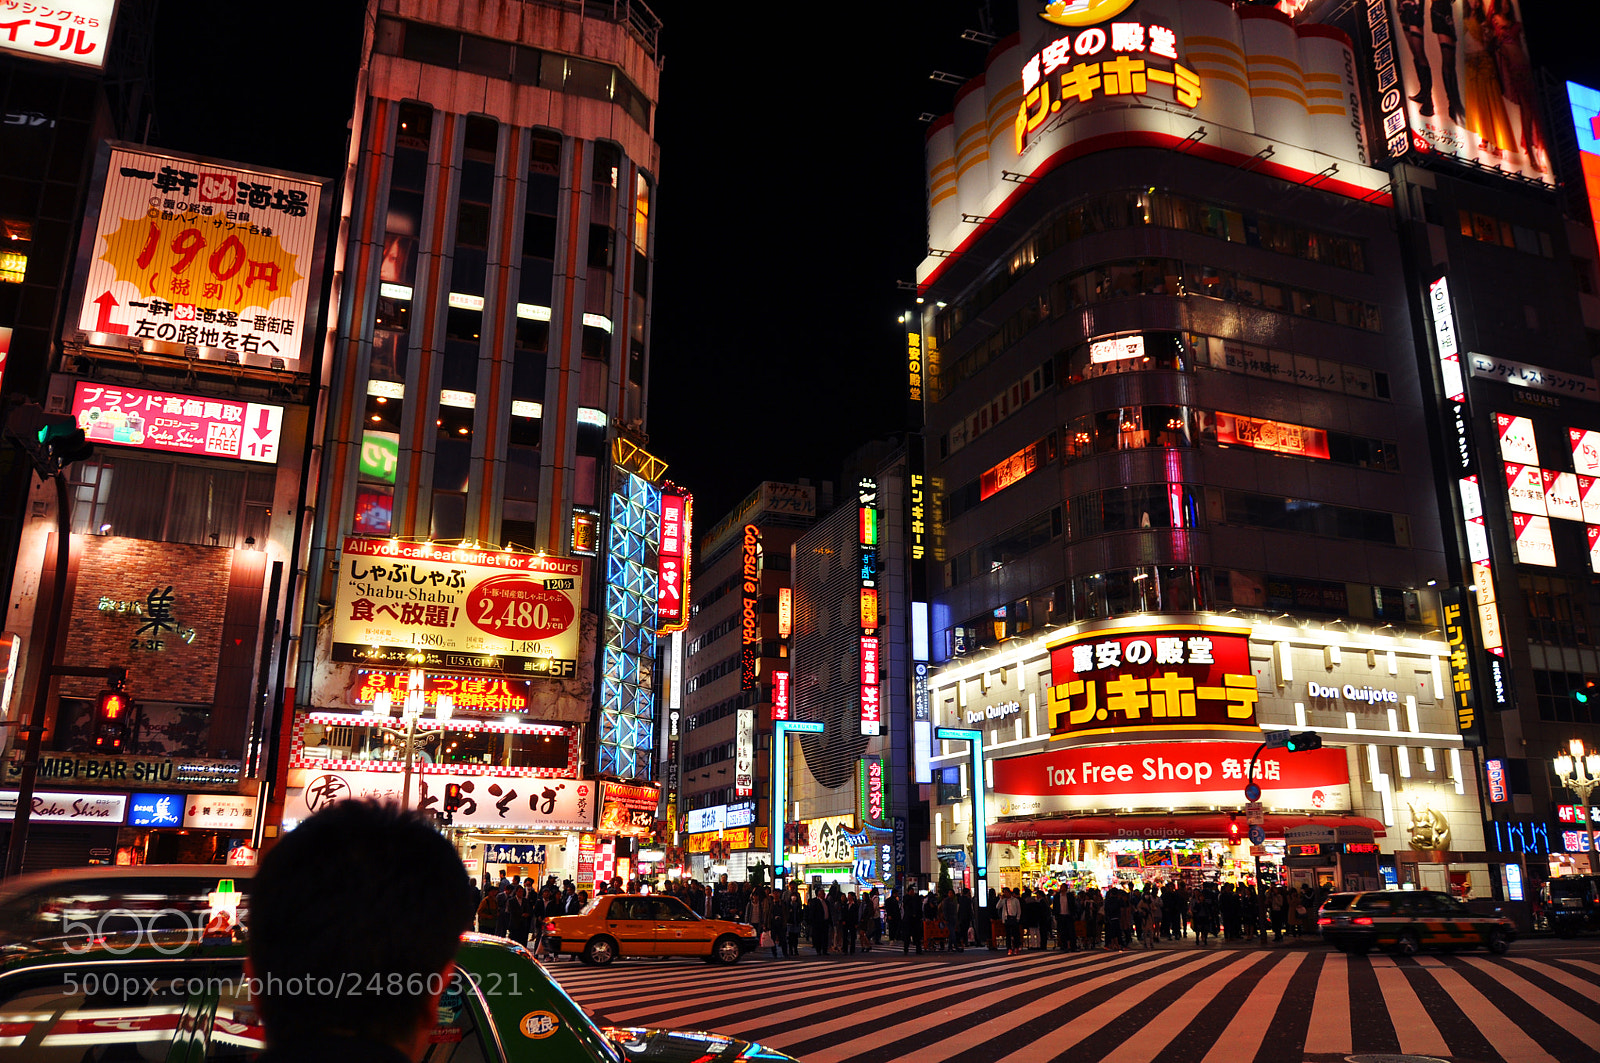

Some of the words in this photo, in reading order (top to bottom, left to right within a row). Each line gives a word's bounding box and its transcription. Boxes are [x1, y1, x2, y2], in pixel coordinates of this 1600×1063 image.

[120, 165, 310, 218] 一軒め酒場
[134, 319, 280, 355] 左の路地を右へ
[1475, 359, 1518, 378] エンタメ
[83, 387, 243, 423] ブランド高価買取
[155, 418, 199, 430] ロコシーラ
[1498, 416, 1510, 426] 8F
[211, 425, 239, 440] TAX
[1570, 430, 1581, 441] 9F
[207, 438, 238, 452] FREE
[247, 442, 274, 458] 1F
[1506, 465, 1518, 476] 4F
[663, 507, 679, 553] 居酒屋
[349, 539, 456, 562] All-you-can-eat
[460, 549, 500, 567] buffet
[504, 556, 525, 568] for
[528, 557, 538, 569] 2
[540, 557, 579, 573] hours
[743, 524, 760, 593] Capsule
[351, 559, 467, 588] しゃぶしゃぶ
[545, 579, 572, 591] 120分
[477, 598, 549, 630] 2,480
[547, 621, 563, 630] yen
[742, 597, 758, 645] booth
[442, 639, 456, 648] yen
[450, 656, 501, 669] USAGIYA
[1072, 637, 1215, 673] 驚安の殿堂
[548, 660, 574, 677] 5F
[1308, 681, 1340, 699] Don
[1343, 684, 1398, 706] Quijote
[967, 710, 985, 724] Don
[986, 701, 1020, 720] Quijote
[1046, 765, 1076, 787] Tax
[1082, 762, 1134, 784] Free
[1142, 756, 1213, 785] Shop
[1221, 758, 1281, 781] 免税店
[606, 784, 641, 798] OKONOMI
[643, 789, 660, 799] YAKI
[868, 762, 882, 819] カラオケ
[1558, 806, 1573, 821] 4F
[1117, 828, 1140, 838] Don
[1143, 827, 1186, 840] Quijote
[881, 844, 892, 881] カラオケ
[525, 1016, 555, 1035] 優良
